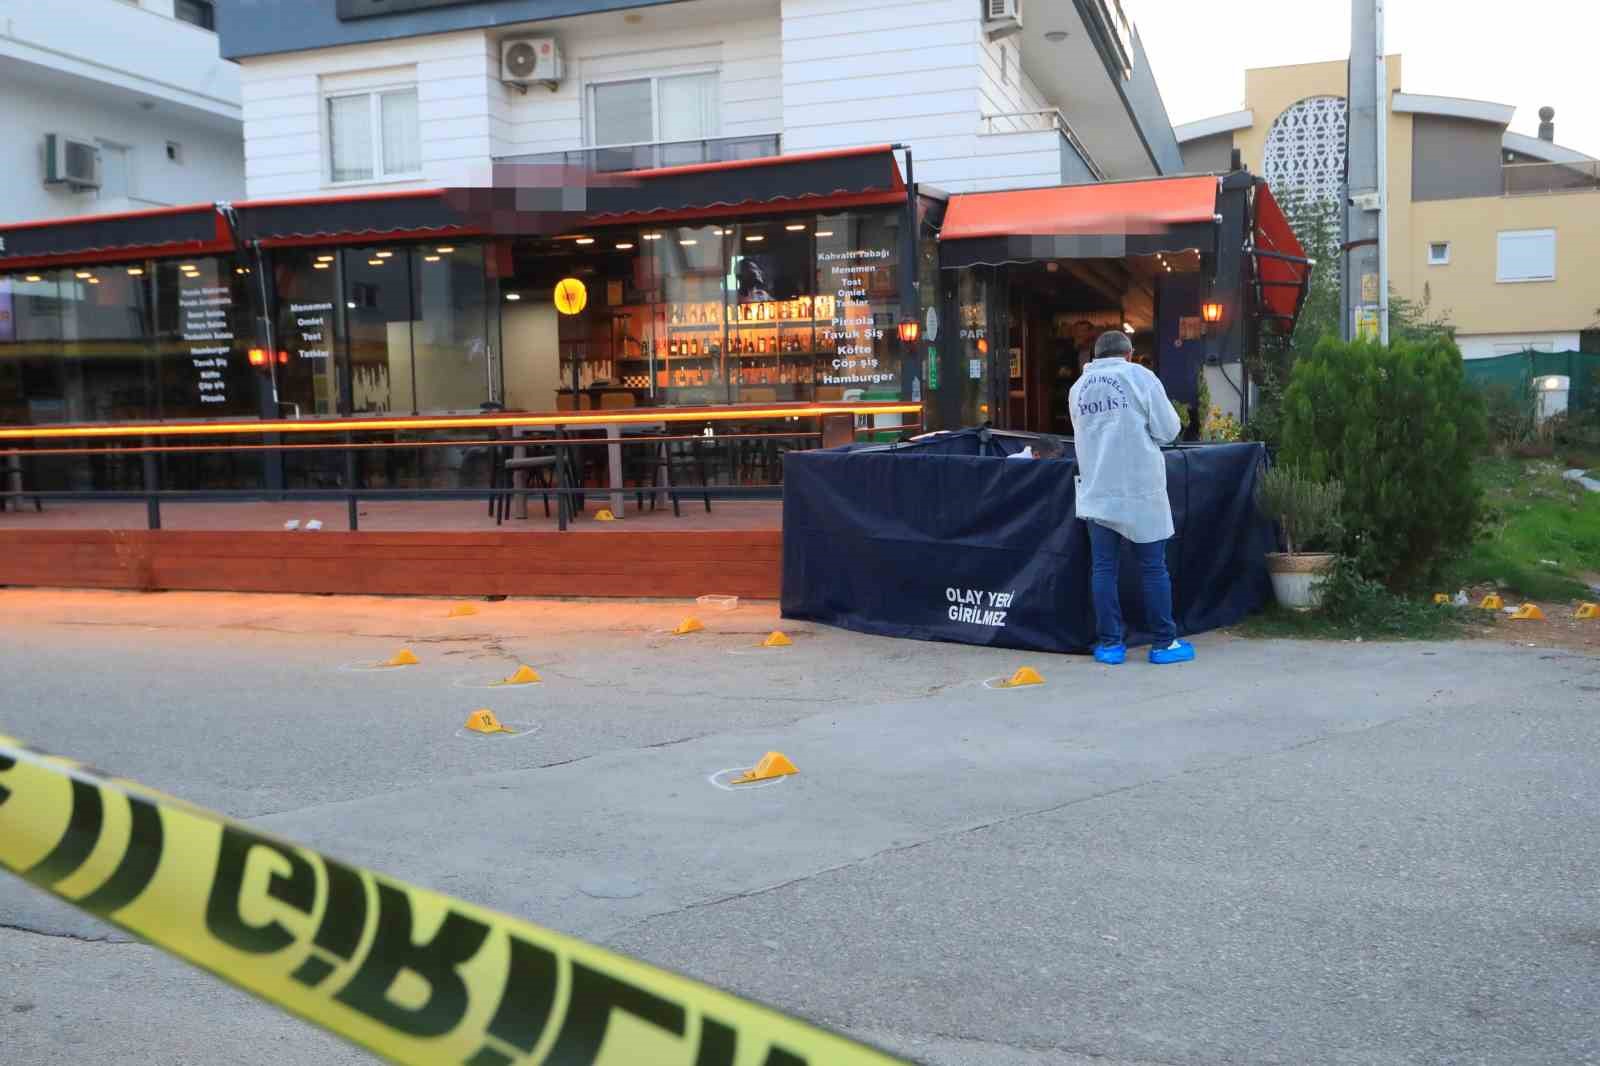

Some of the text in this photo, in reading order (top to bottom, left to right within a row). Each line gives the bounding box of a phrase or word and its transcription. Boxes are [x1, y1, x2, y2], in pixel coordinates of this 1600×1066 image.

[831, 265, 876, 274] Menemen
[841, 278, 862, 286] Tost
[823, 373, 894, 384] Hamburger
[1079, 396, 1119, 416] POLİS
[945, 587, 1016, 608] OLAY YERİ
[948, 603, 1007, 627] GİRİLMEZ
